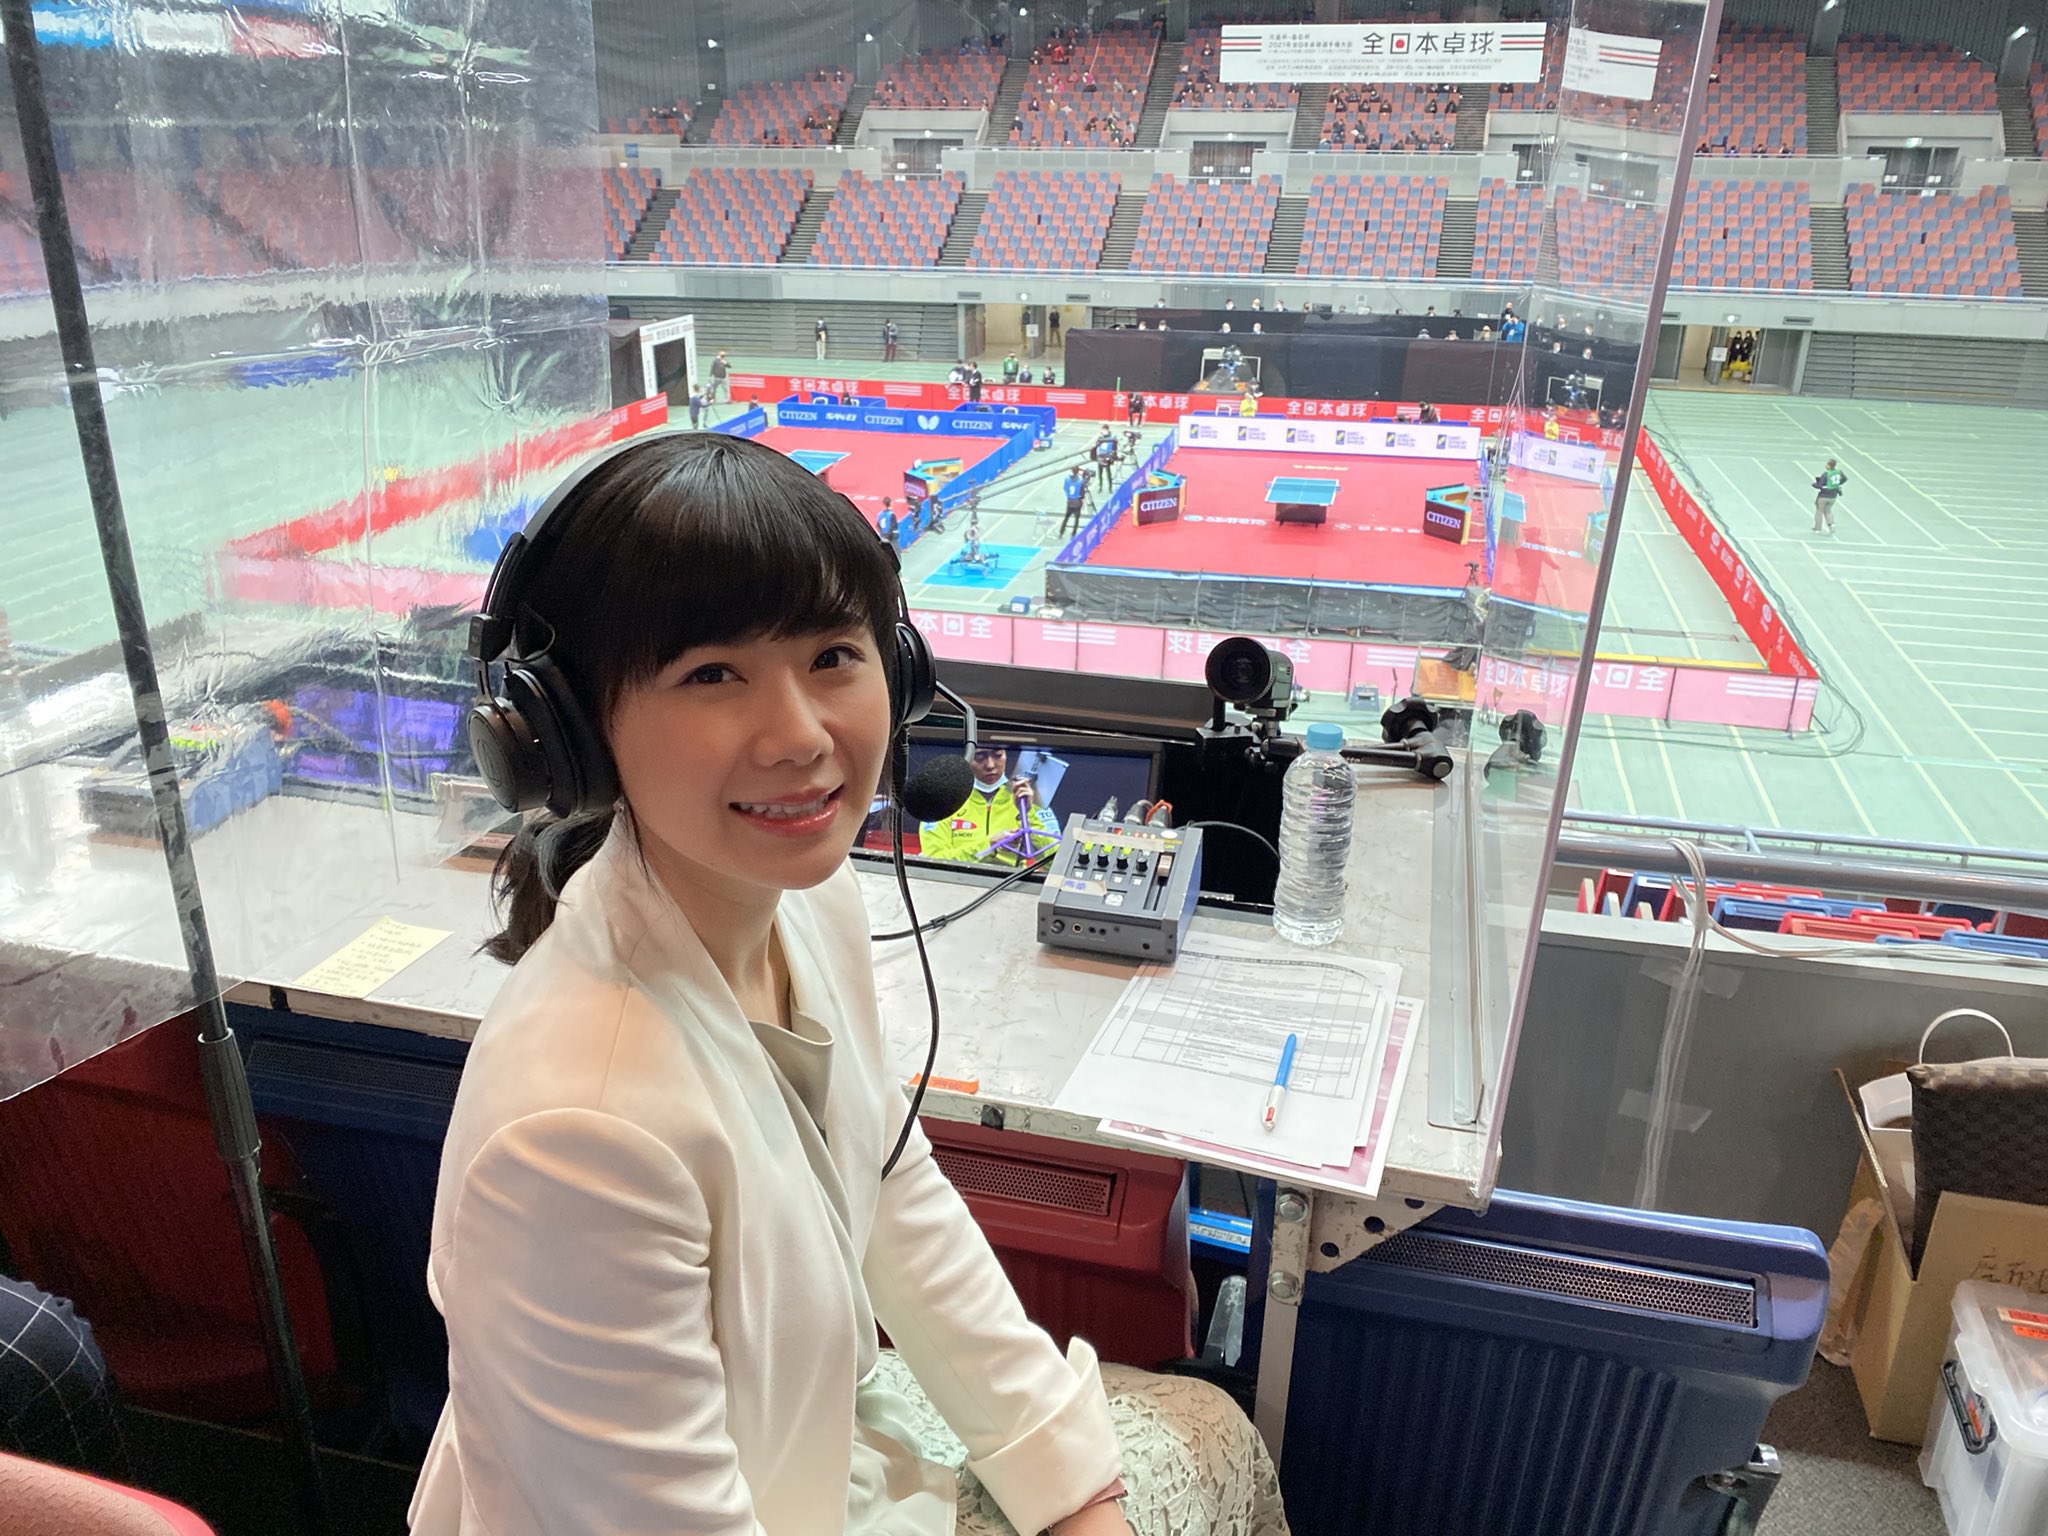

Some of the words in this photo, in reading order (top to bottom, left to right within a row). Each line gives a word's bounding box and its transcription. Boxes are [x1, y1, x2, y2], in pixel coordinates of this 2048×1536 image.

[1362, 31, 1495, 55] 全日本卓球
[789, 378, 860, 393] 全日本卓球
[1113, 394, 1189, 410] 全本卓球
[1287, 400, 1367, 417] 全日本卓球
[779, 410, 818, 421] CITIZEN
[864, 414, 904, 425] CITIZEN
[952, 419, 993, 430] CITIZEN
[1140, 497, 1178, 512] CITIZEN
[1426, 511, 1462, 530] CITIZEN
